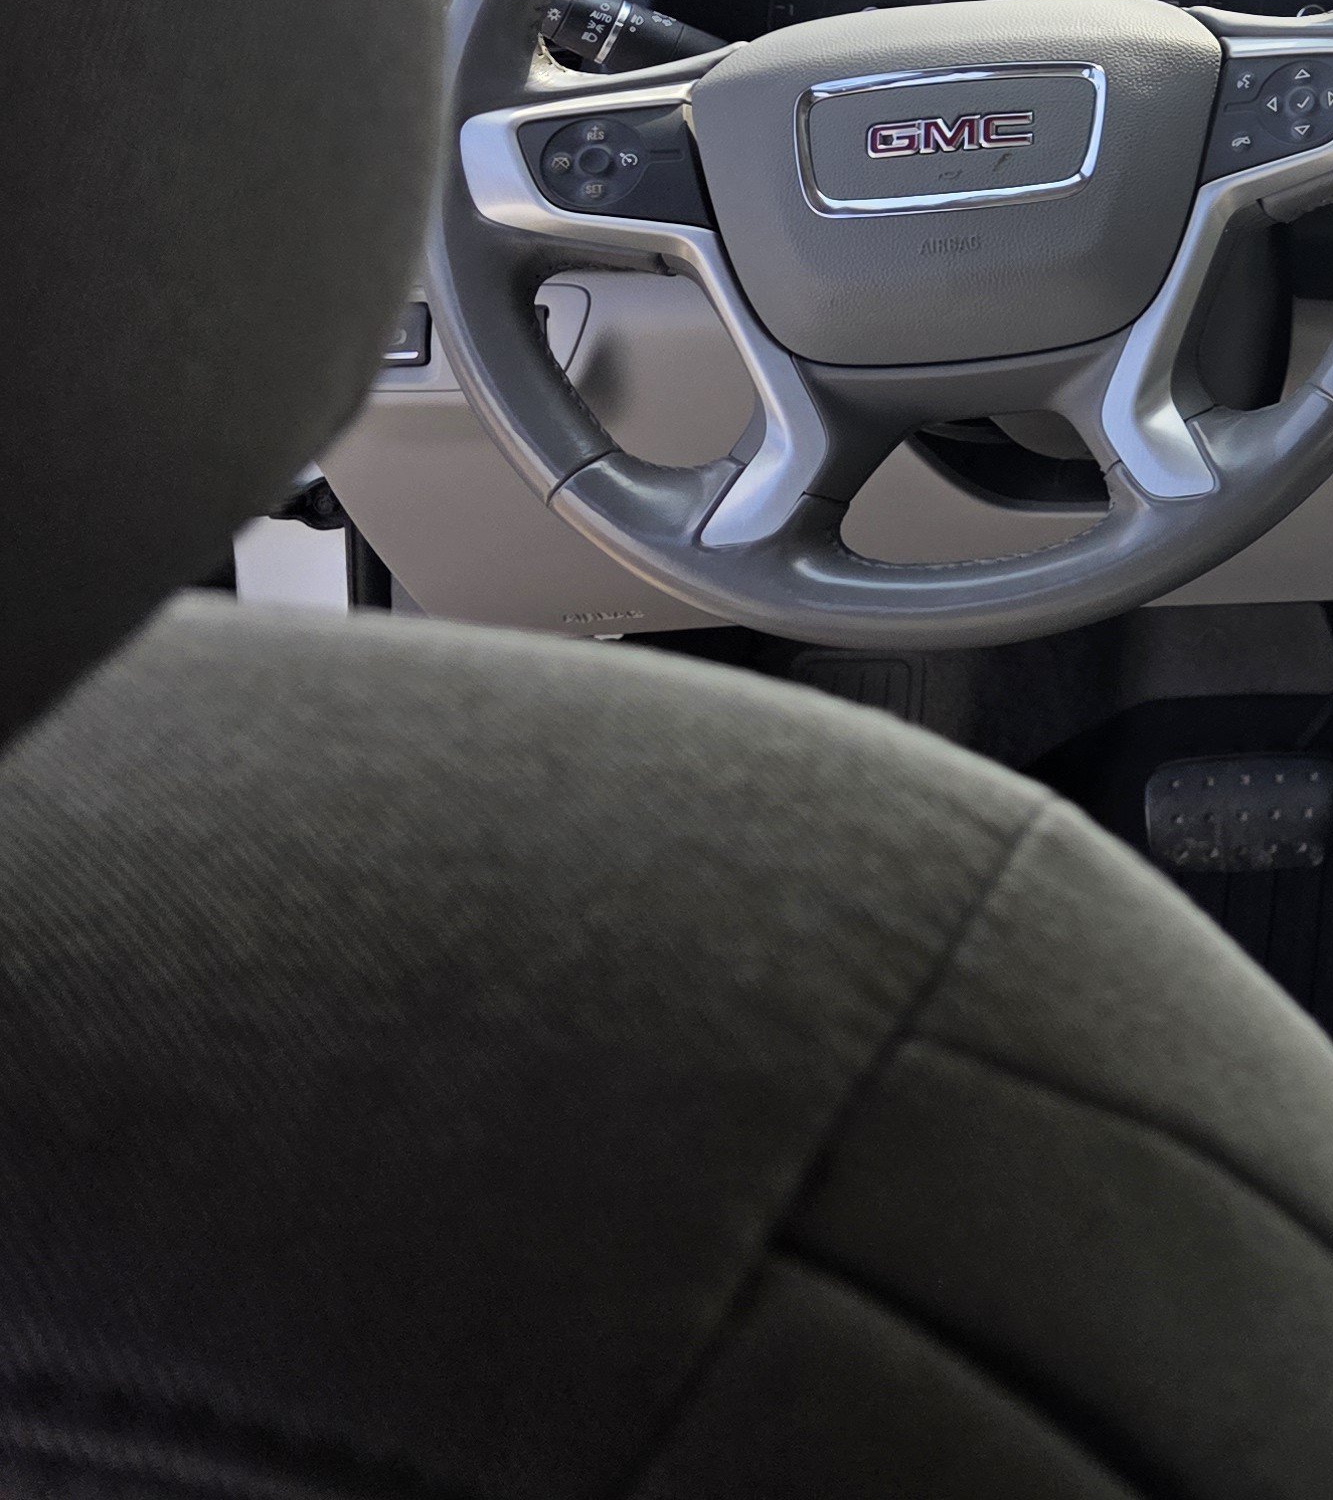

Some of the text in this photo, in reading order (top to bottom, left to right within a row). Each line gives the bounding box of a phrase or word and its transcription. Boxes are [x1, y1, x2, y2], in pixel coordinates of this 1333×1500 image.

[589, 9, 613, 24] AUTO
[586, 130, 605, 141] RES
[867, 111, 1034, 159] GMC
[585, 184, 604, 195] SET
